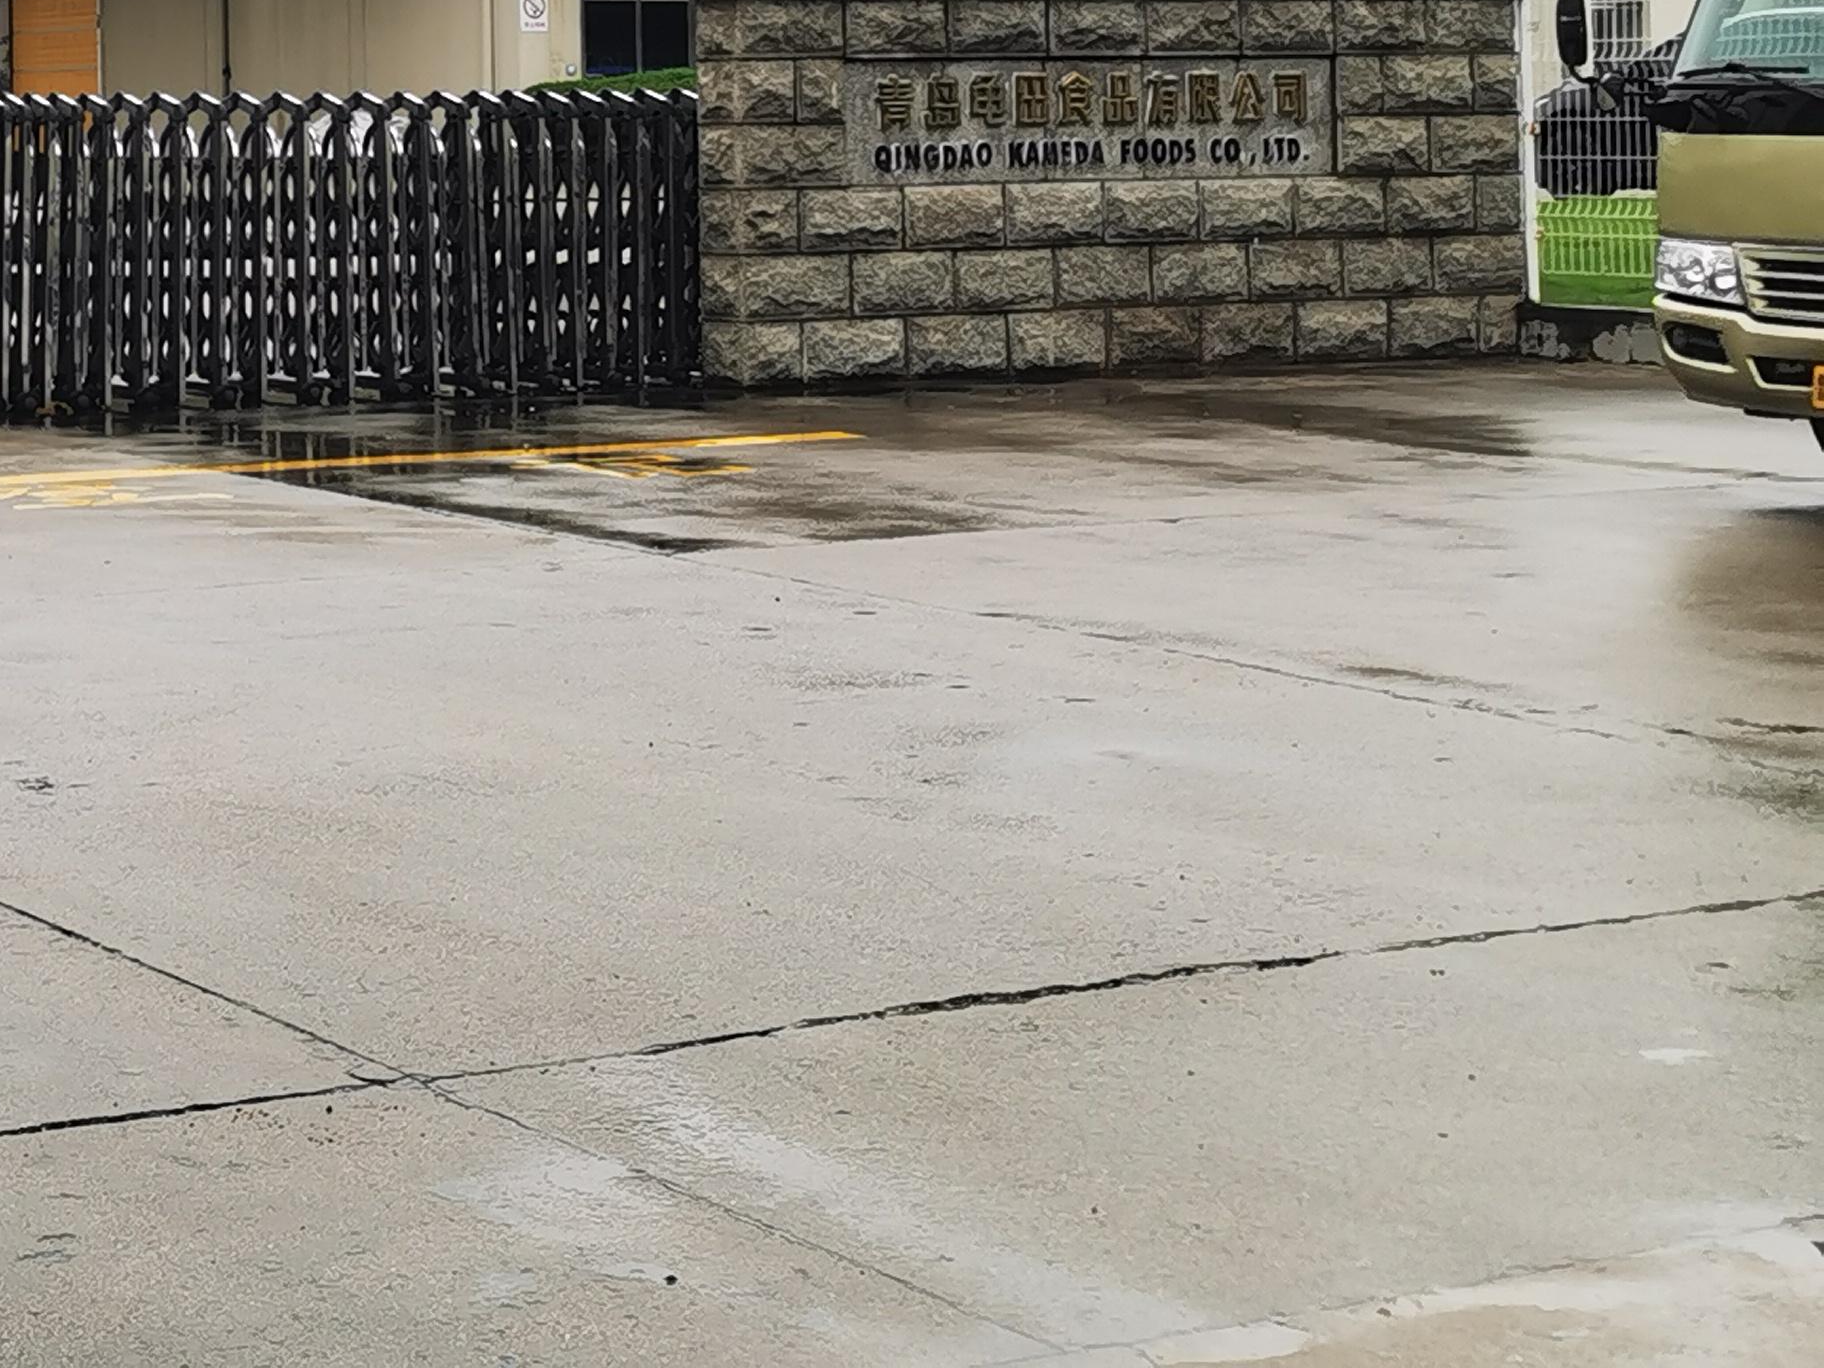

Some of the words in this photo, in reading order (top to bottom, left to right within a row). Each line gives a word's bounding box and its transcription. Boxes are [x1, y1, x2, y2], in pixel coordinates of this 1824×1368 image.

[875, 71, 1310, 129] 青岛龟田食品有限公司
[874, 141, 992, 174] QINGDAO
[1009, 139, 1105, 169] KAMEDA
[1120, 138, 1197, 165] FOODS
